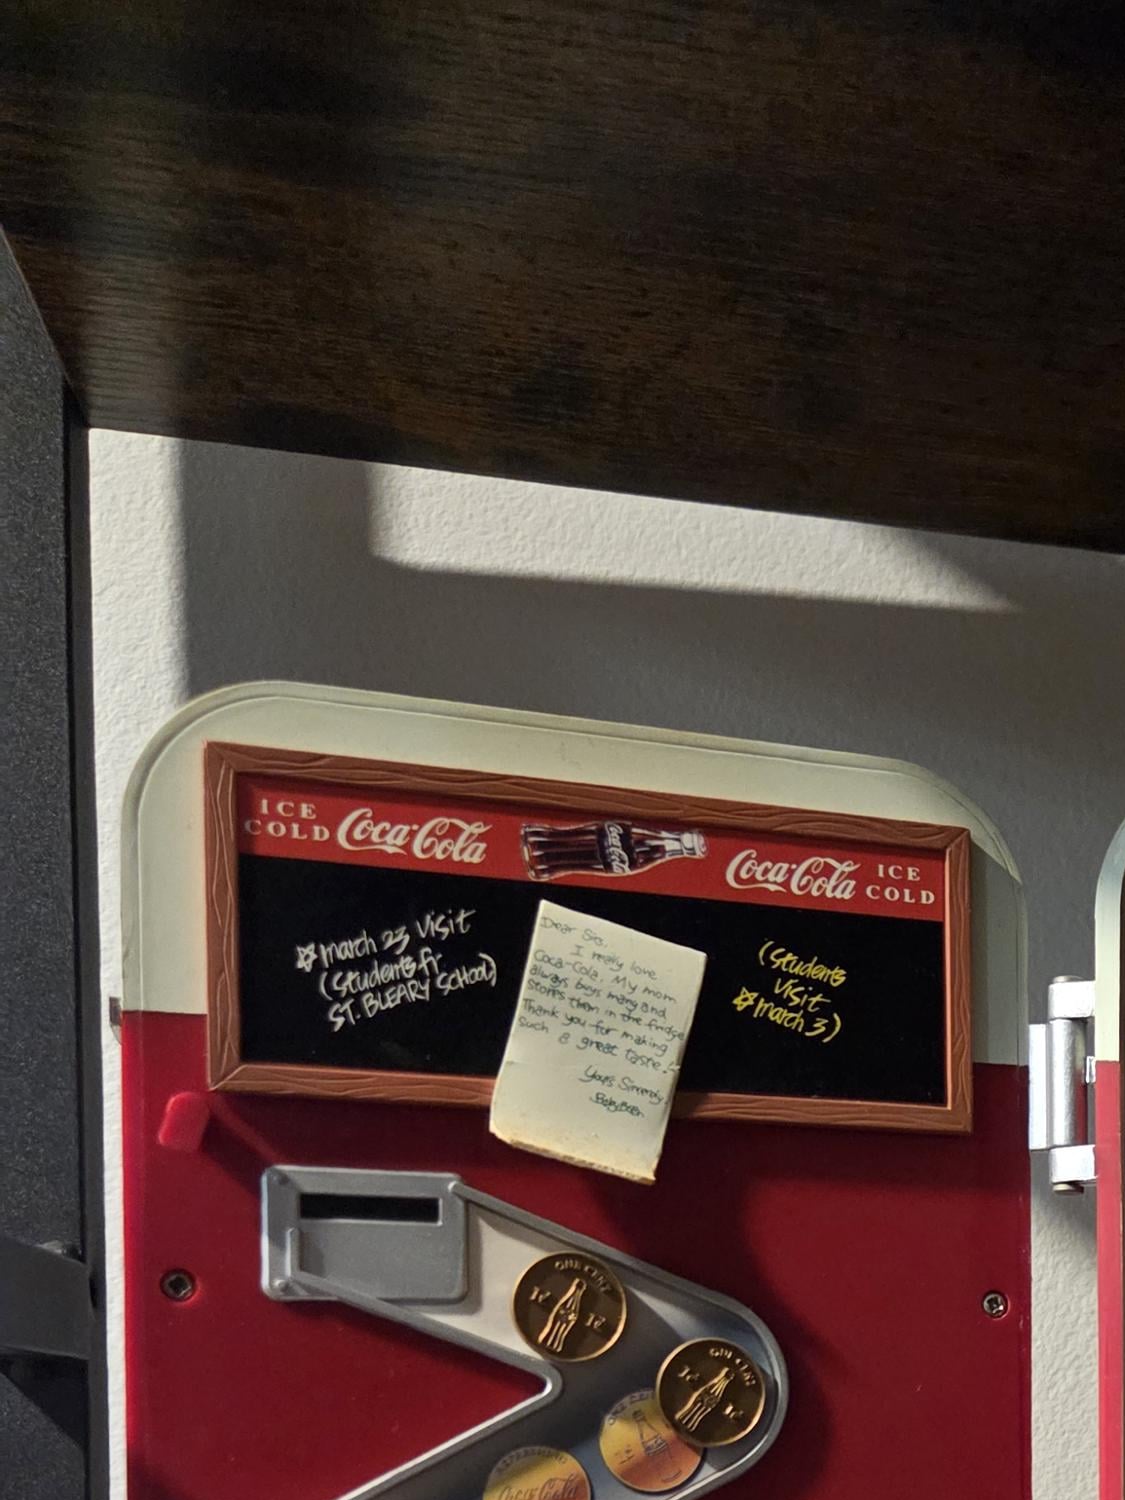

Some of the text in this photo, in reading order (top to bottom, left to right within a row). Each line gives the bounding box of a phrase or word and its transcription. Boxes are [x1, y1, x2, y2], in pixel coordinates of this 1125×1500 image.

[261, 799, 317, 820] ICE
[244, 819, 330, 842] COLD
[337, 807, 493, 864] Coca-Cola
[725, 849, 861, 900] Coca-Cola
[877, 863, 921, 882] ICE
[865, 884, 935, 905] COLD
[381, 925, 410, 955] 23
[362, 977, 431, 1019] BLEARY
